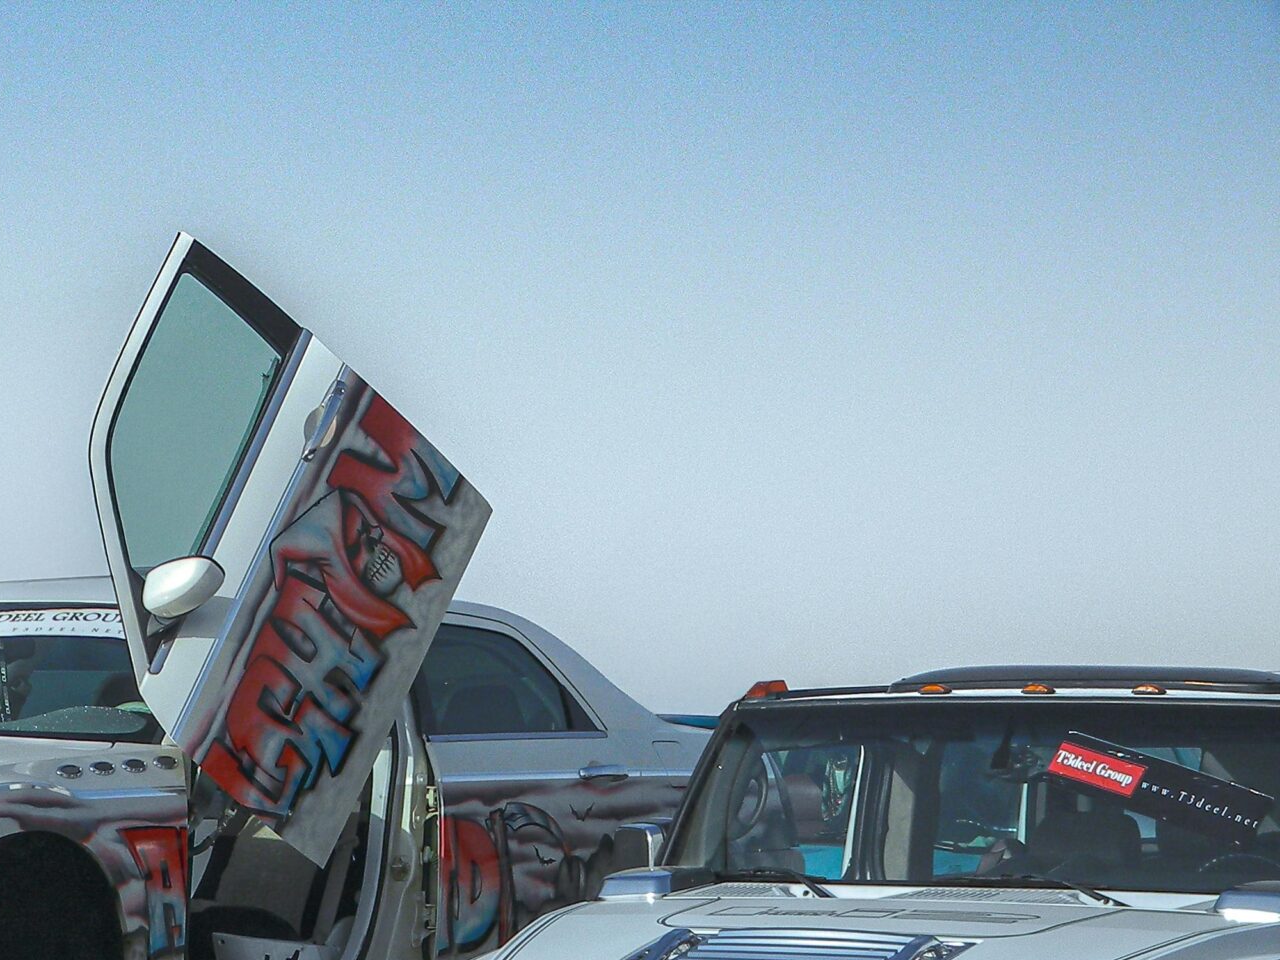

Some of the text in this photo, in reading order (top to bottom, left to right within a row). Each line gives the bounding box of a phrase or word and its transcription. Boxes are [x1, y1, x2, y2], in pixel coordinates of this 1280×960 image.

[52, 612, 122, 623] GROU
[1056, 749, 1133, 787] T3deel Group
